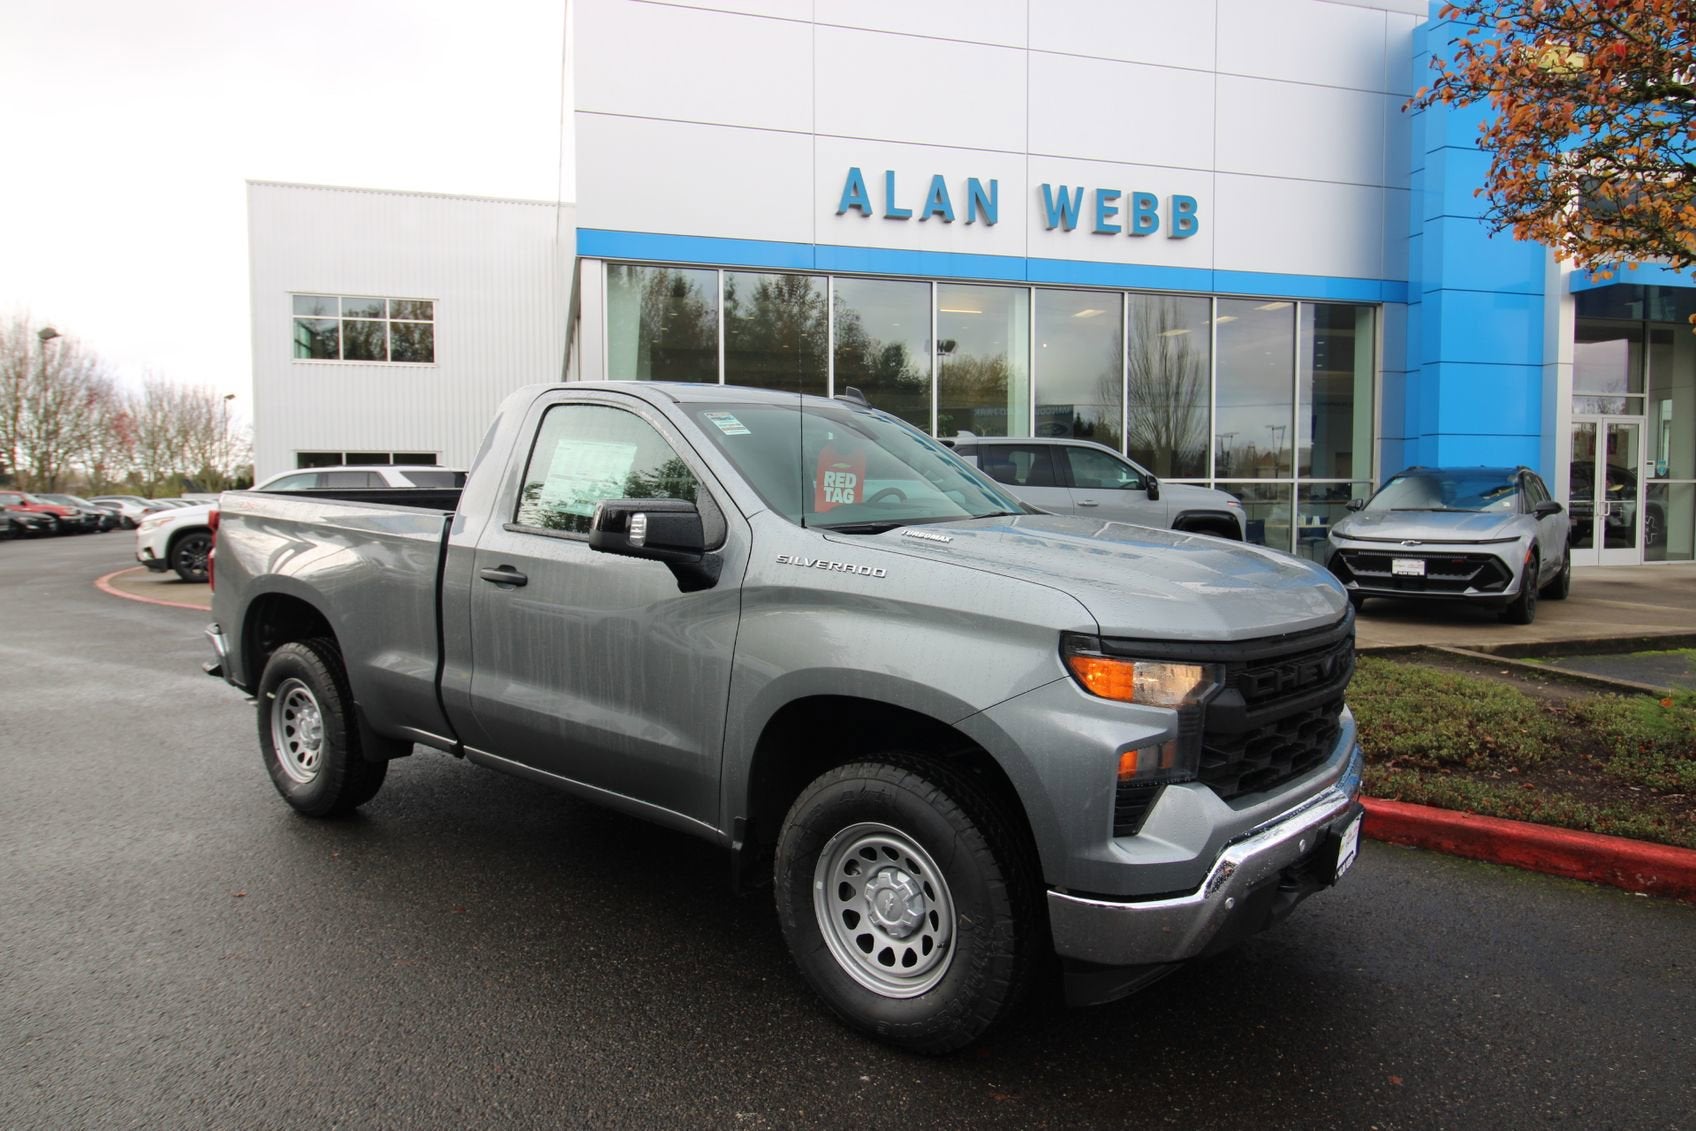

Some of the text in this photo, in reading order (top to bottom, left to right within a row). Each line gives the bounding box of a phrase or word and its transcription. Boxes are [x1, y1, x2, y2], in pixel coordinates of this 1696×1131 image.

[836, 166, 1200, 240] ALAN WEBB
[824, 470, 857, 488] RED
[824, 486, 855, 504] TAG
[776, 554, 888, 578] SILVERADO
